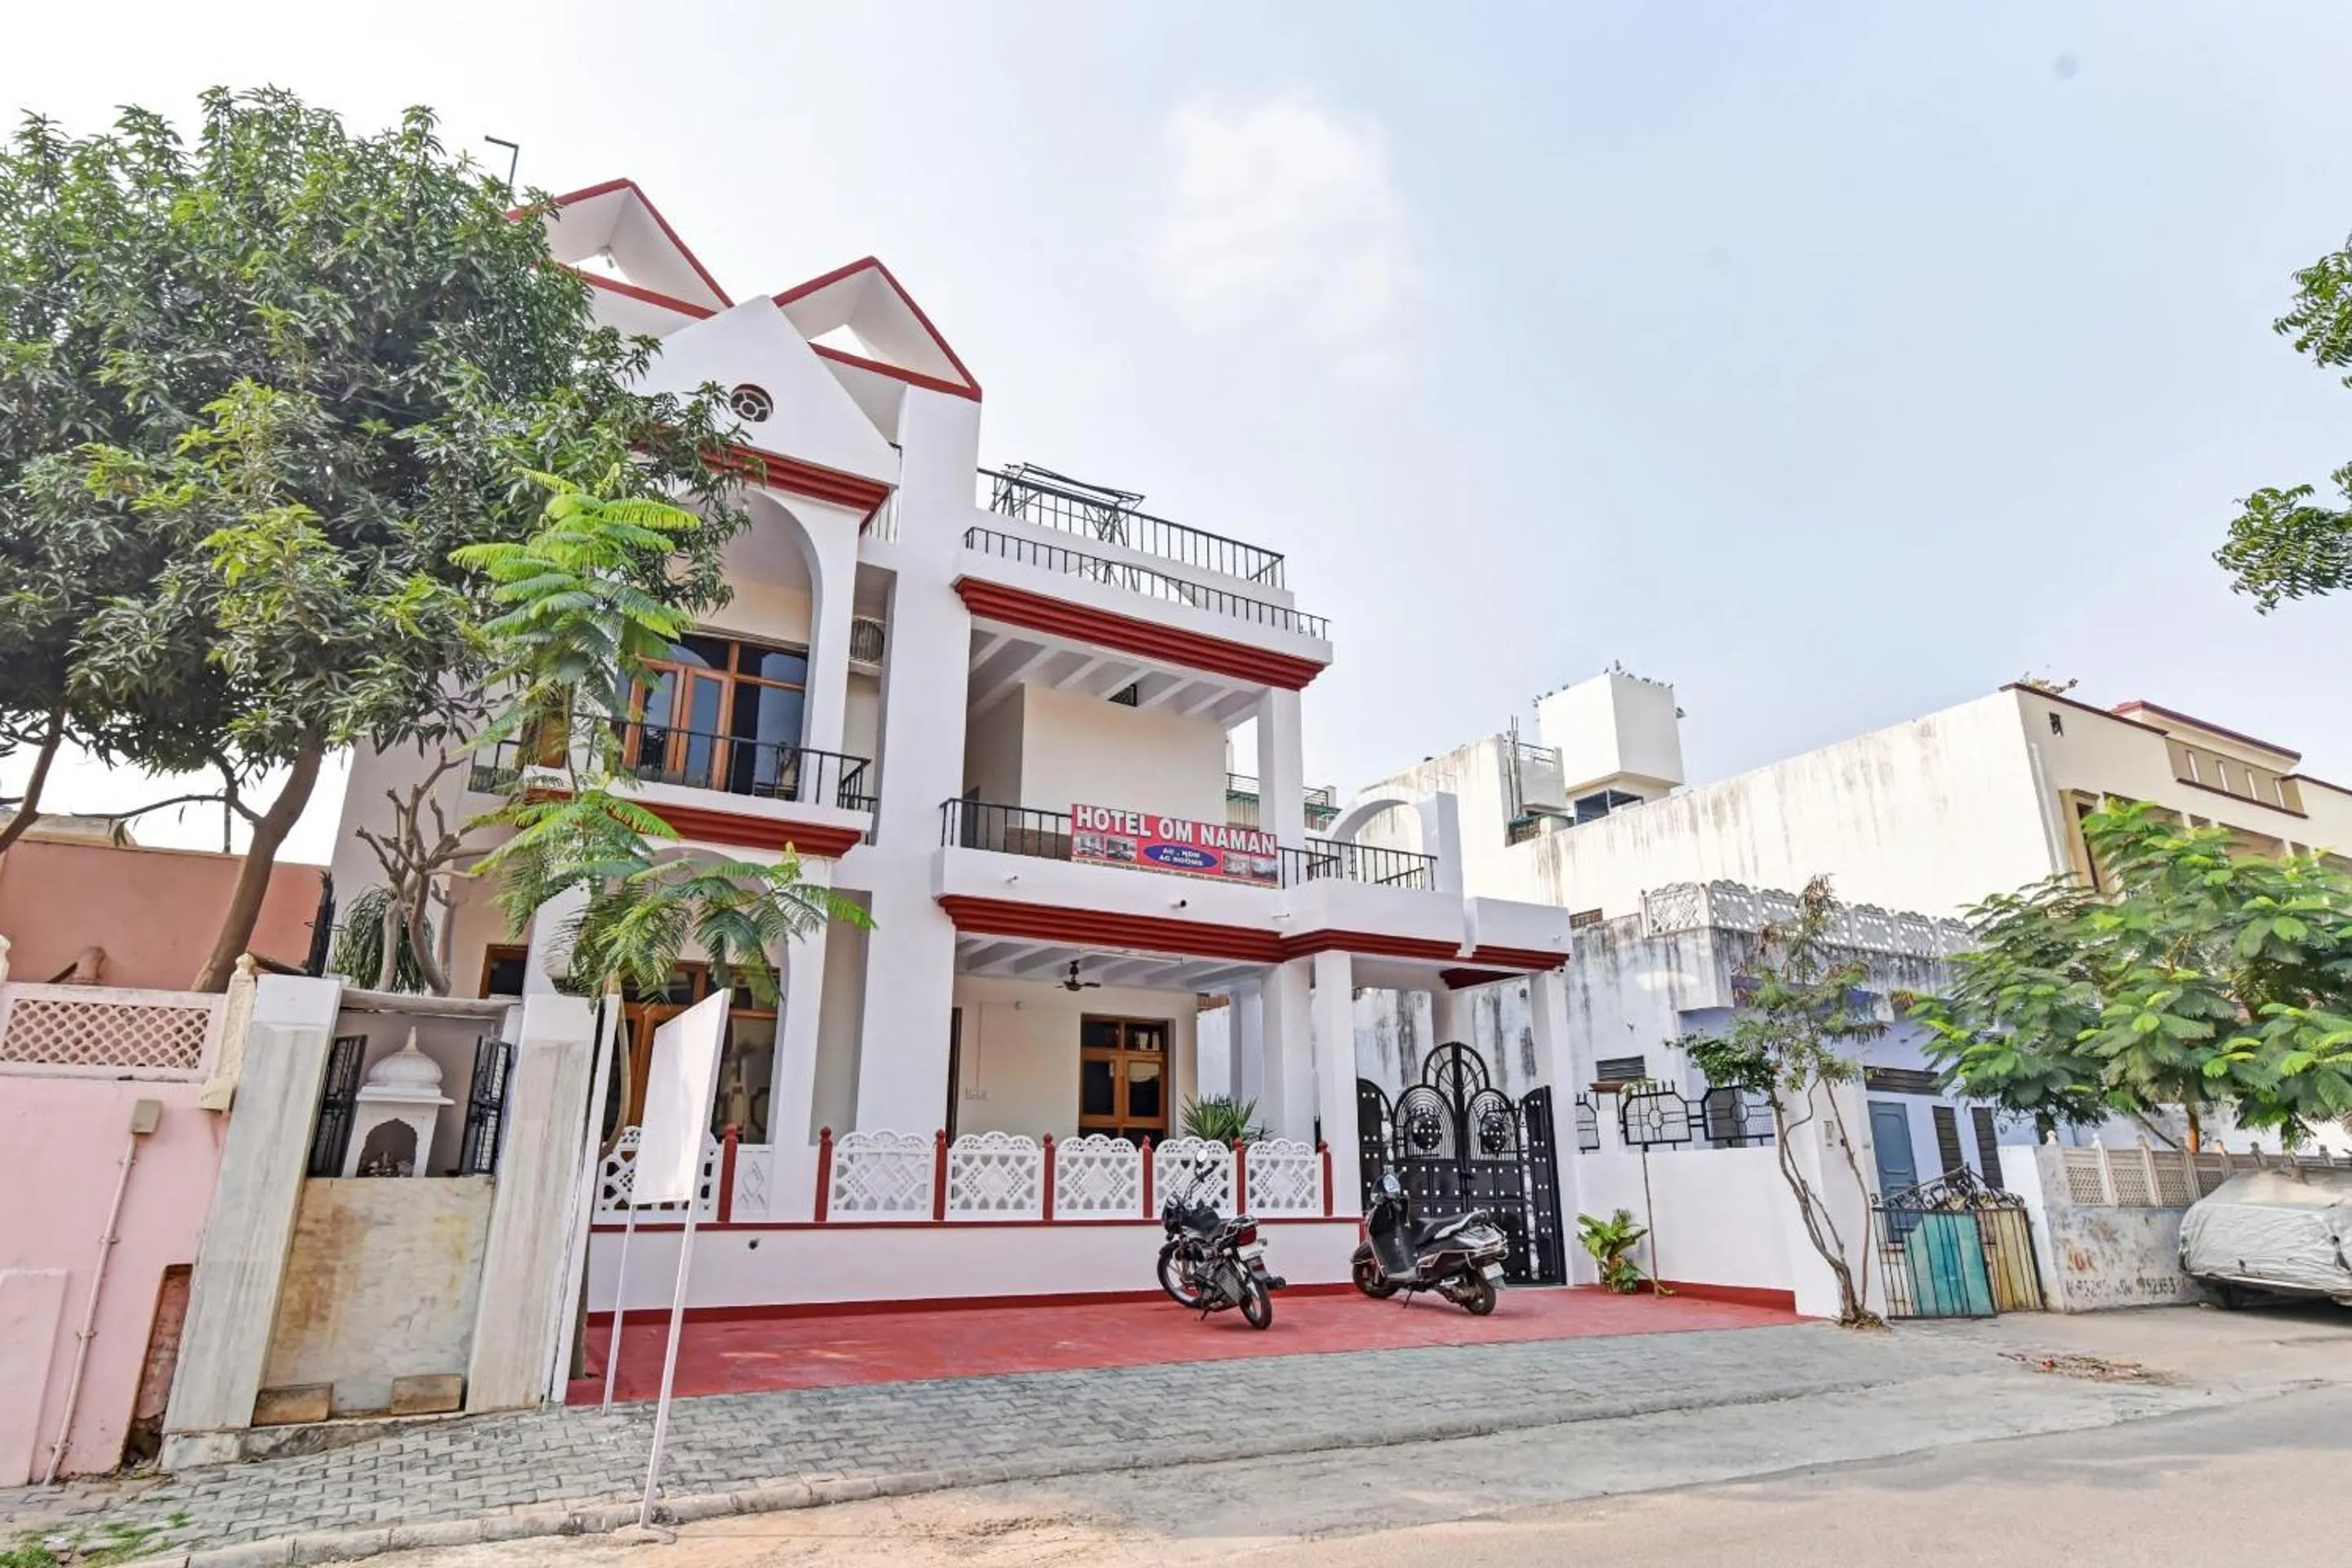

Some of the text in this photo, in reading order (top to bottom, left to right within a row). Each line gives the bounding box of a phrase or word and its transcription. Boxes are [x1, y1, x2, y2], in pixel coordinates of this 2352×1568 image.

[1076, 805, 1275, 855] HOTEL OM NAMAN
